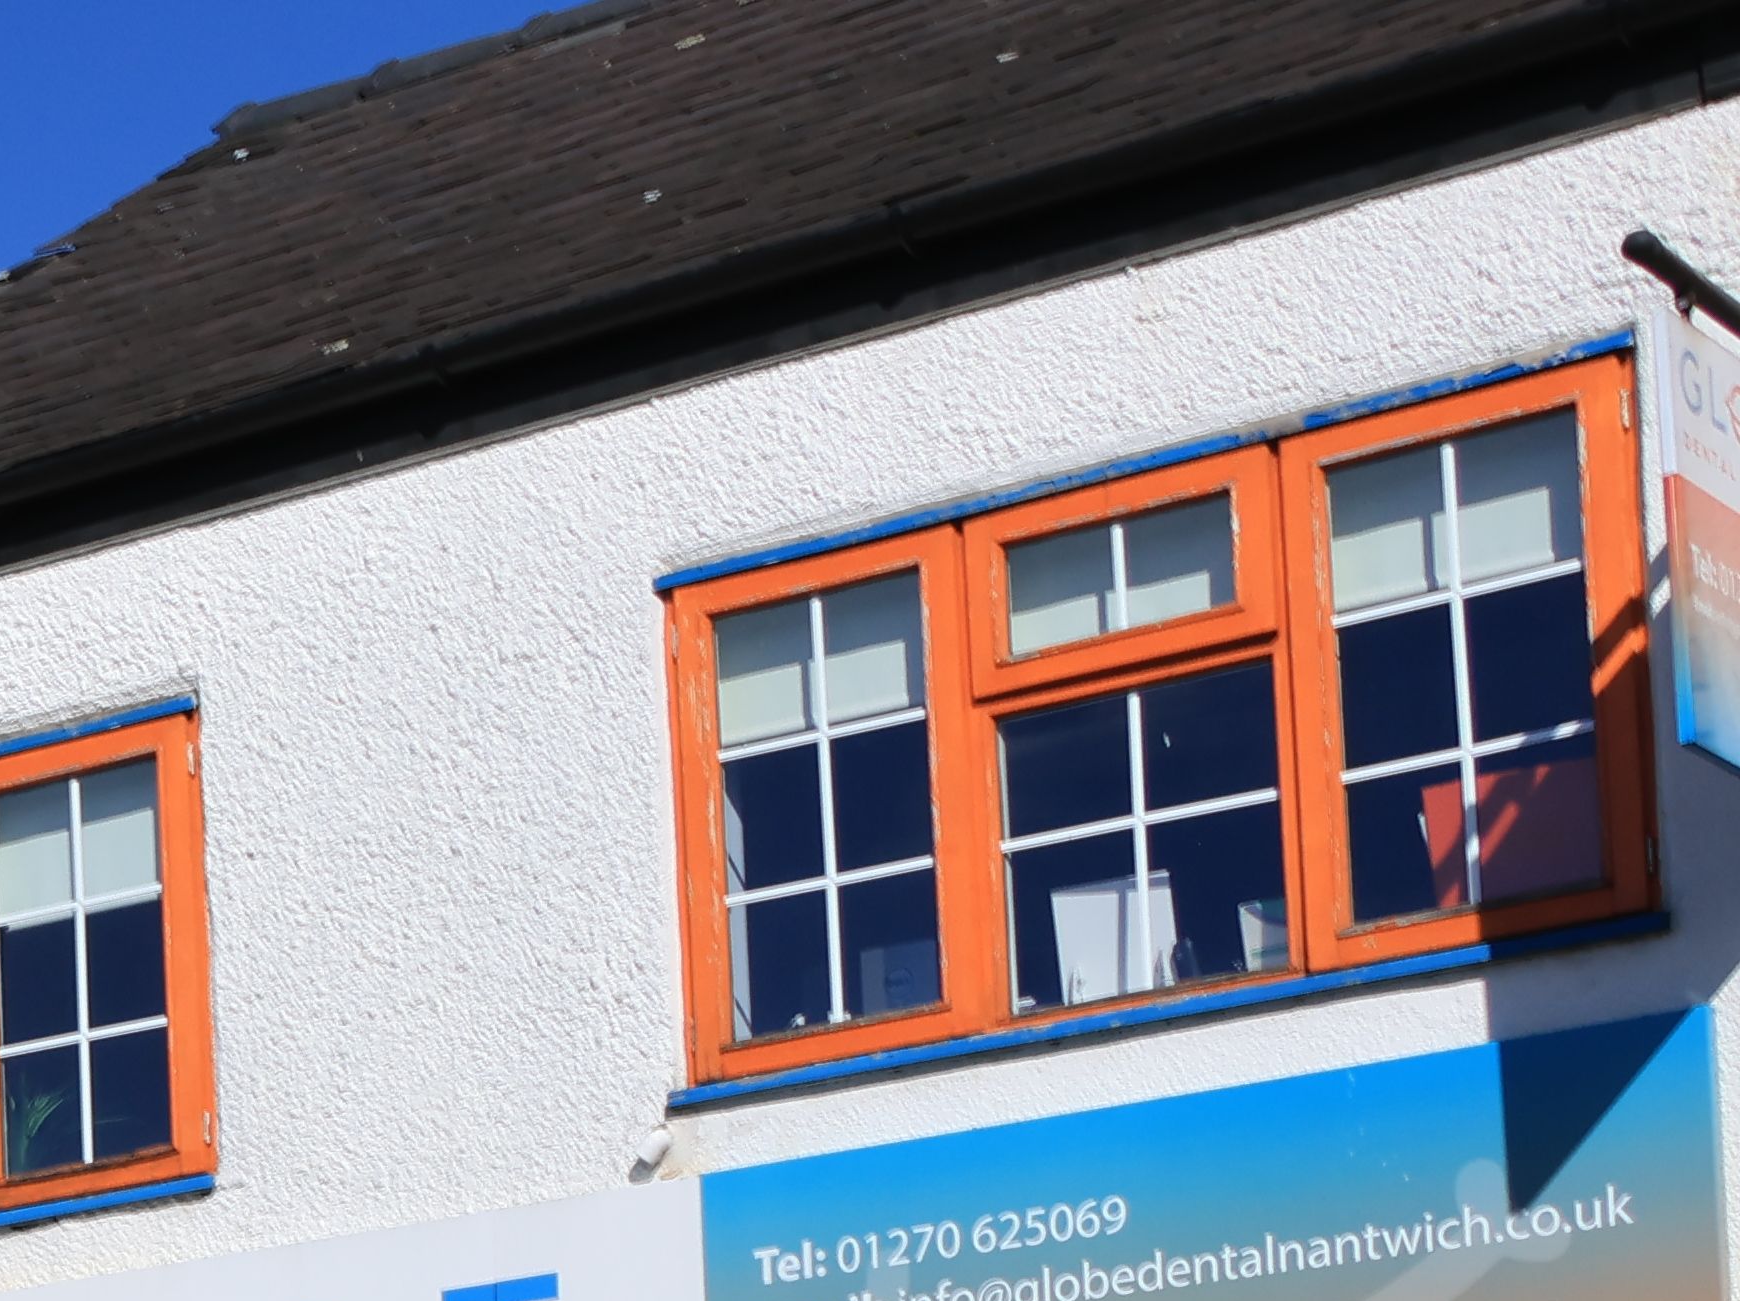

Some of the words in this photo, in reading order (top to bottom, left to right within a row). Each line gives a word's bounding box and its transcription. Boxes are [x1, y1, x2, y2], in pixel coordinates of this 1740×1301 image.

[753, 1239, 827, 1285] Tel:
[836, 1221, 961, 1274] 01270
[972, 1194, 1127, 1254] 625069
